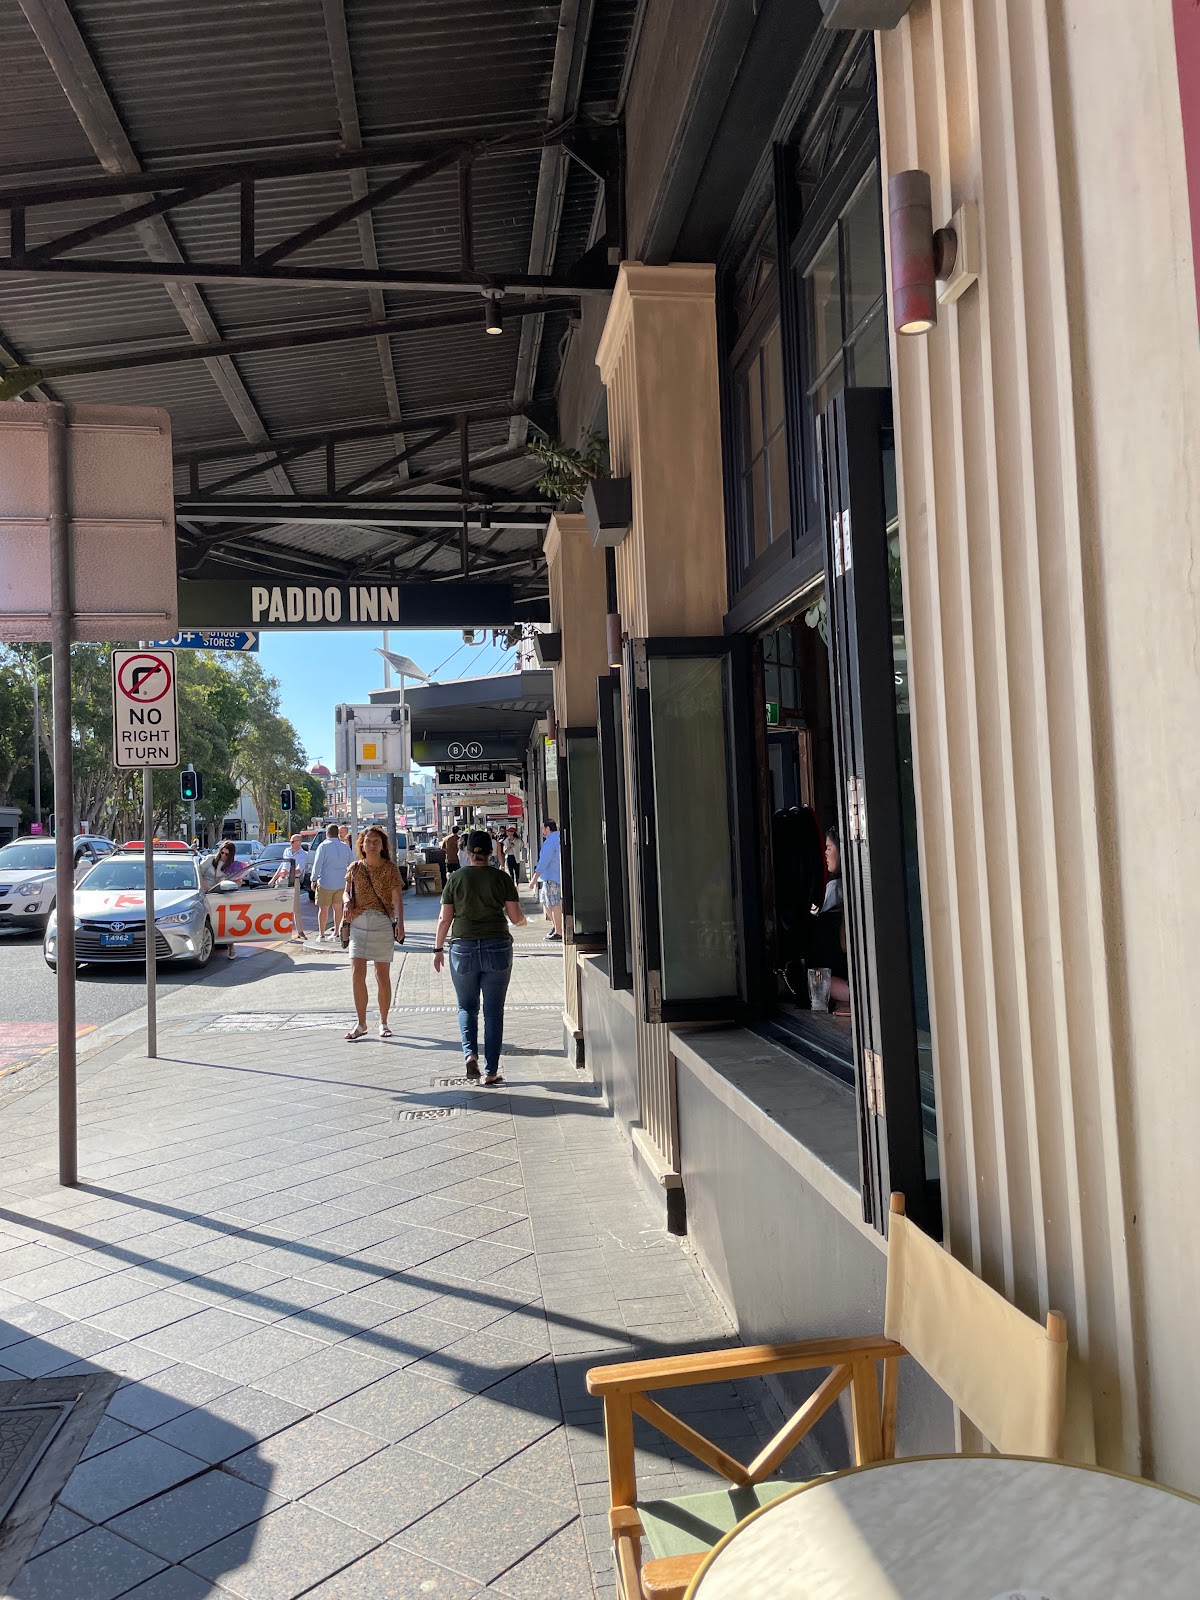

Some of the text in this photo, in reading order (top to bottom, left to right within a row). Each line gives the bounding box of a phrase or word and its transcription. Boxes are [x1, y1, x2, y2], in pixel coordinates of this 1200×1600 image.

[252, 586, 400, 622] PADDO INN
[203, 638, 235, 647] STORES
[130, 708, 161, 725] NO
[122, 730, 170, 742] RIGHT
[125, 747, 168, 759] TURN
